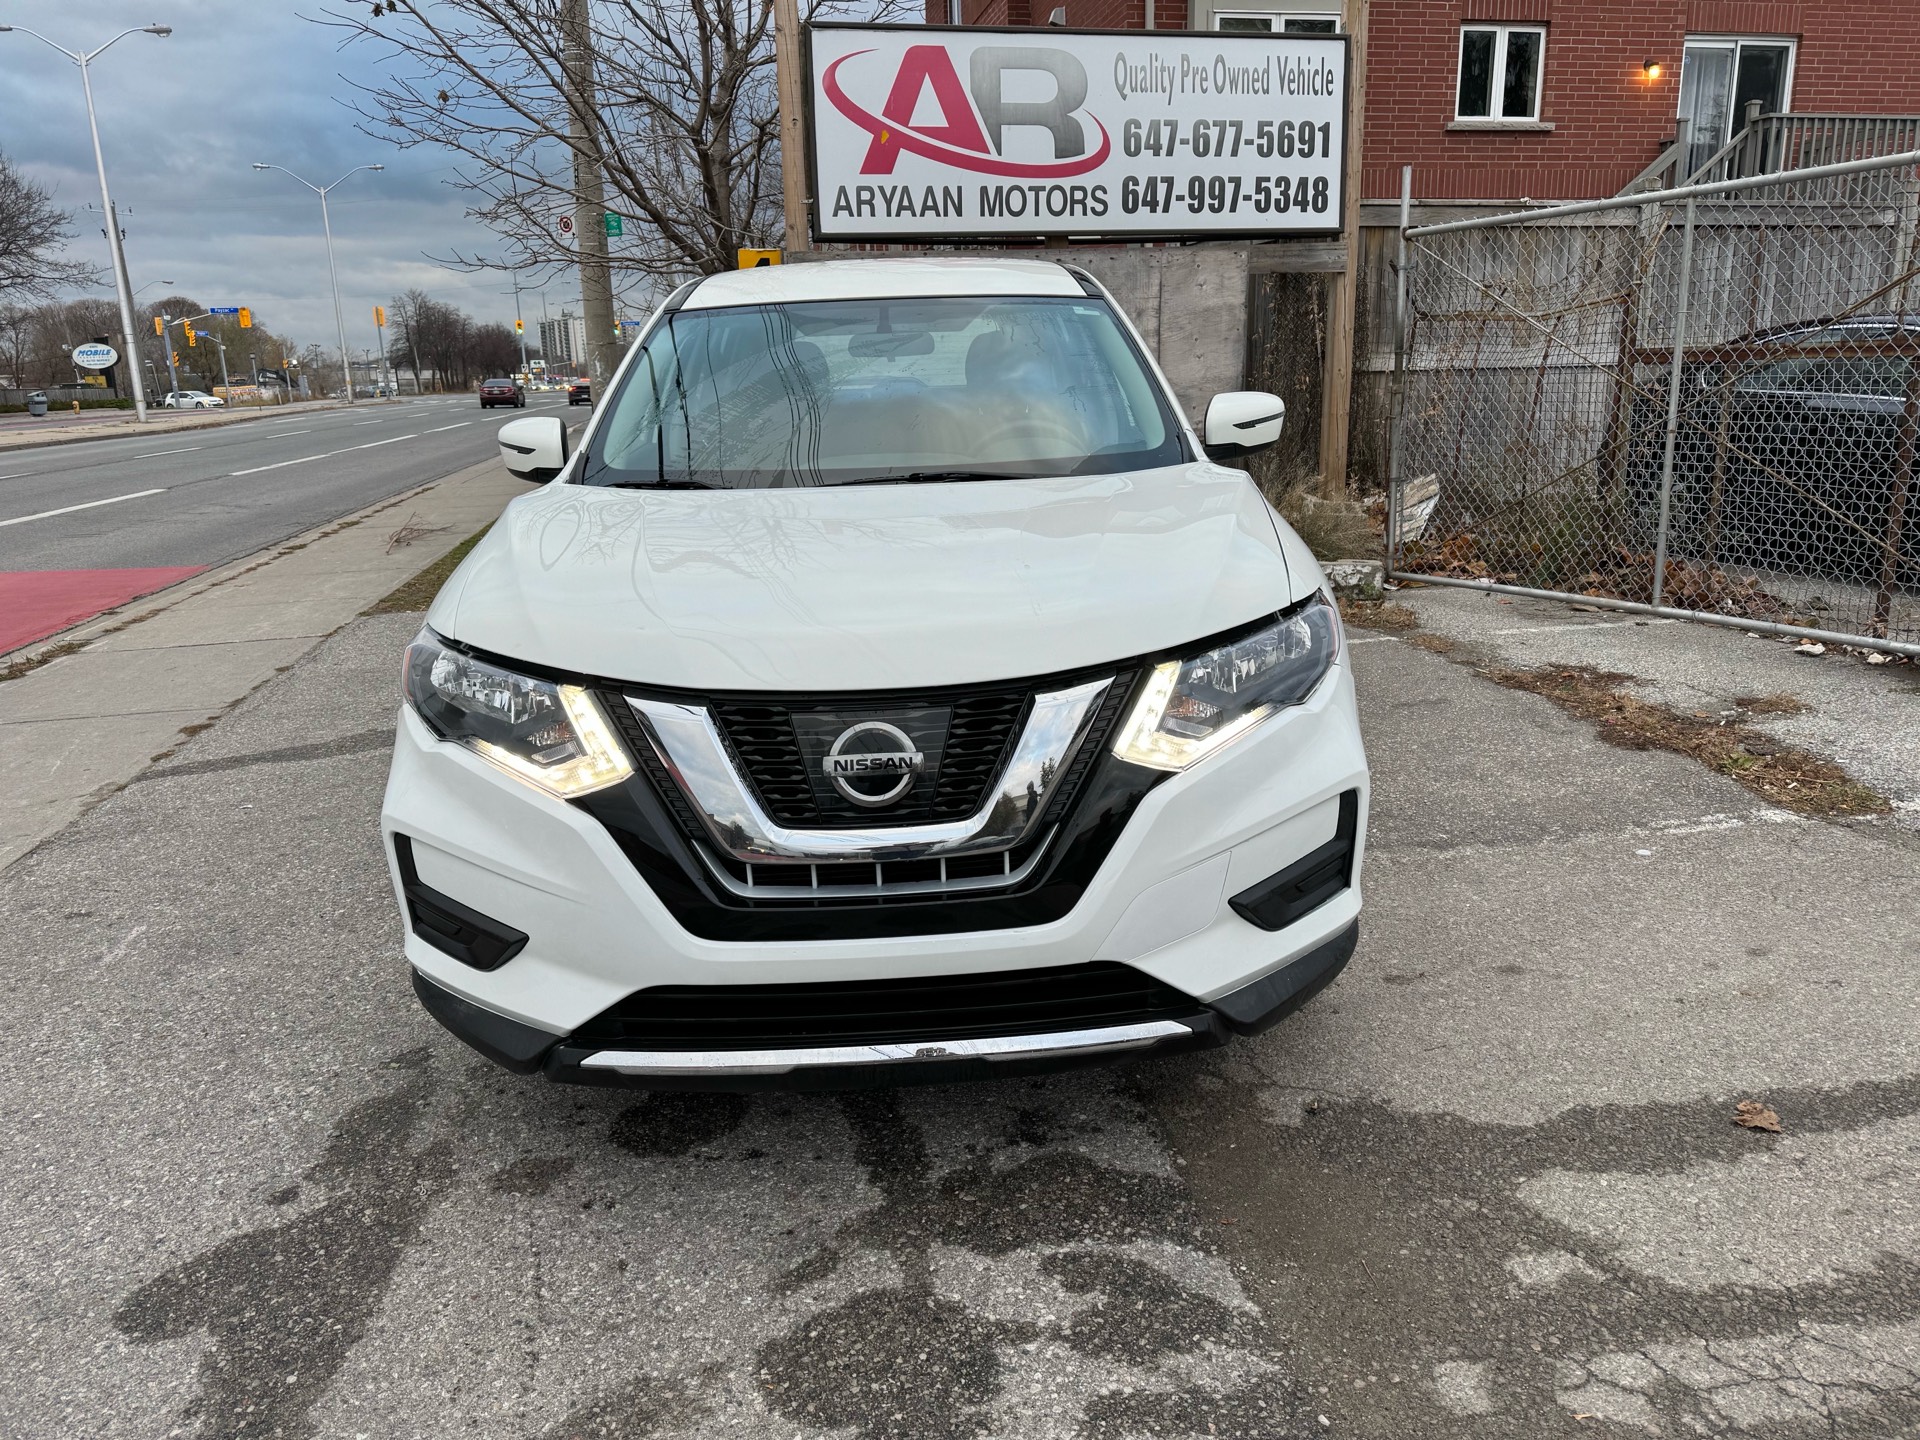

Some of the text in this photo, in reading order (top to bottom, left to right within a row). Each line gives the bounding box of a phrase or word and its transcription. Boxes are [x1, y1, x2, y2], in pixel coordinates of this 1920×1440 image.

[1113, 51, 1334, 106] Quality Pre Owned Vehicle
[859, 45, 1088, 175] AR
[1123, 118, 1331, 159] 647-677-5691
[832, 184, 1109, 218] ARYAAN MOTORS
[1121, 175, 1329, 214] 647-997-5348
[77, 348, 112, 357] MOBILE
[833, 757, 913, 772] NISSAN
